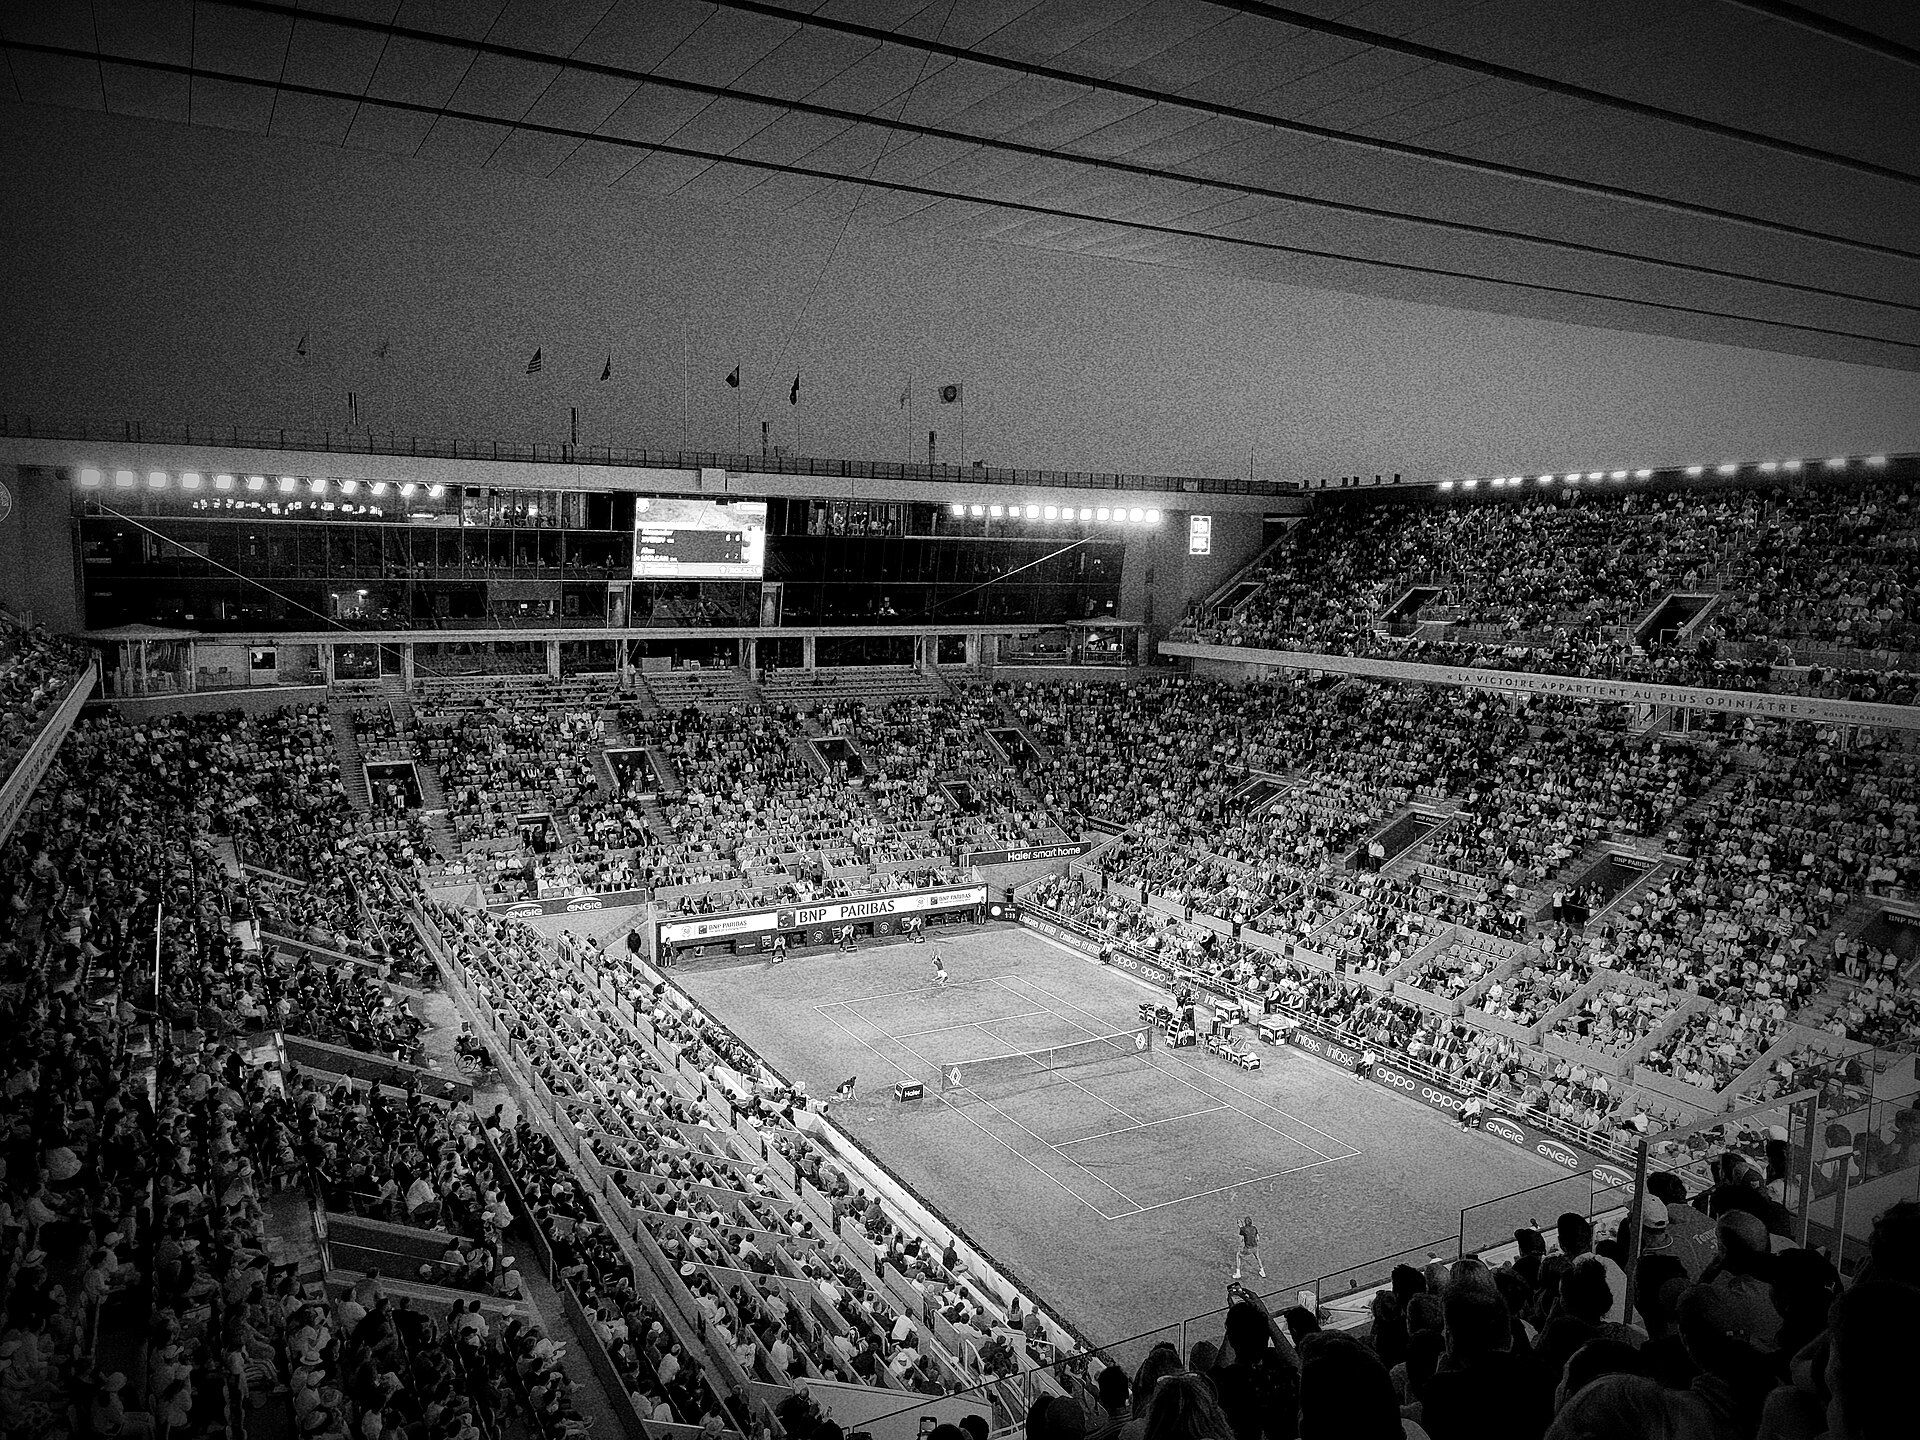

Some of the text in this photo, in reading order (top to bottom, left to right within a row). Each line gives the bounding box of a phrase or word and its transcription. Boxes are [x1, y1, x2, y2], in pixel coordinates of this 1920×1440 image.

[1458, 673, 1471, 682] LA
[1476, 675, 1535, 688] VICTOIRE
[1541, 682, 1627, 697] APPARTIENT
[1633, 690, 1652, 699] AU
[1660, 692, 1696, 704] PLUS
[1705, 696, 1799, 713] OPINIÂTRE
[1007, 845, 1081, 862] Haier smart home
[799, 900, 895, 923] BNP PARIBAS
[1113, 953, 1138, 969] oppo
[1140, 965, 1166, 982] oppo
[1294, 1031, 1321, 1052] Infosys
[1326, 1044, 1355, 1066] Infosys
[1376, 1067, 1415, 1091] oppo
[1421, 1087, 1463, 1111] oppo
